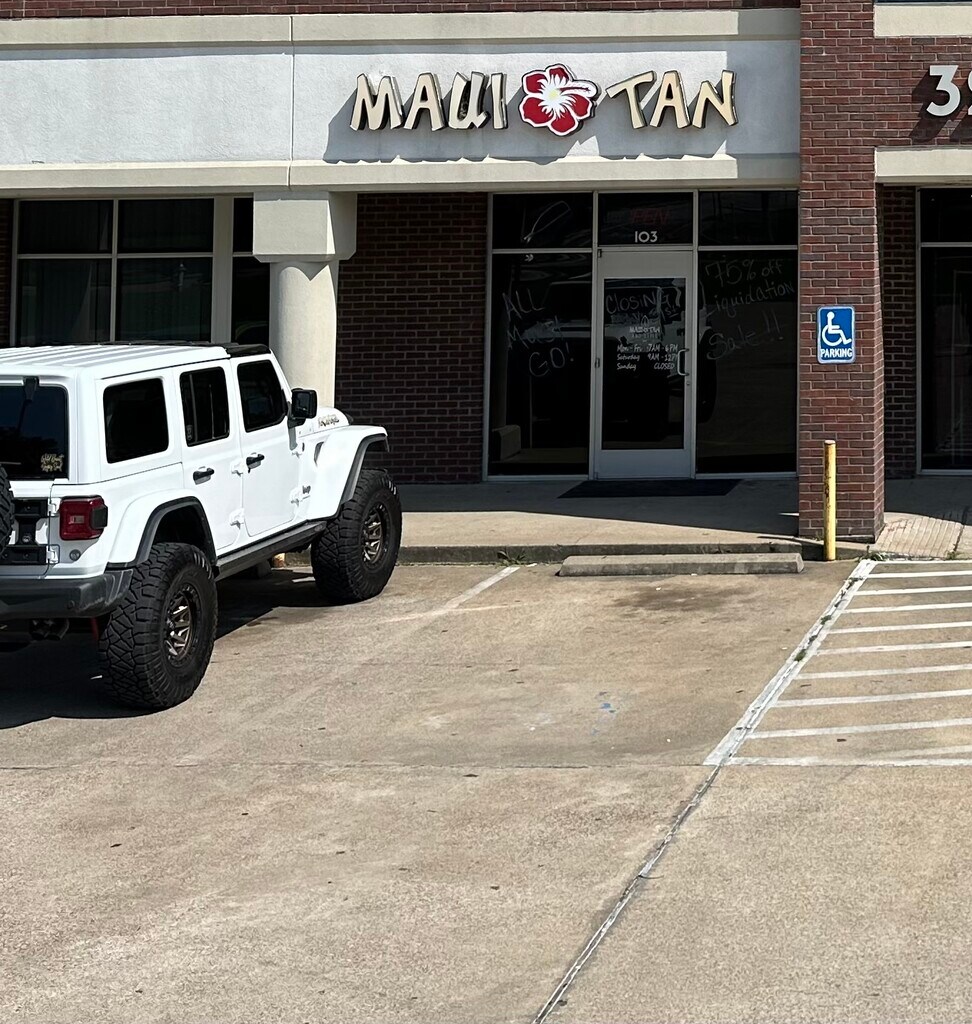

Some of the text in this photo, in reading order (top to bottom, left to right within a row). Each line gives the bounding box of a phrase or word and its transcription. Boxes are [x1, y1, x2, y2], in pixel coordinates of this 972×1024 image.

[349, 70, 739, 132] MAUI TAN
[634, 230, 658, 243] 103
[704, 259, 757, 288] 75%
[502, 287, 546, 322] ALL
[528, 342, 575, 377] GO!
[820, 348, 853, 358] PARKING
